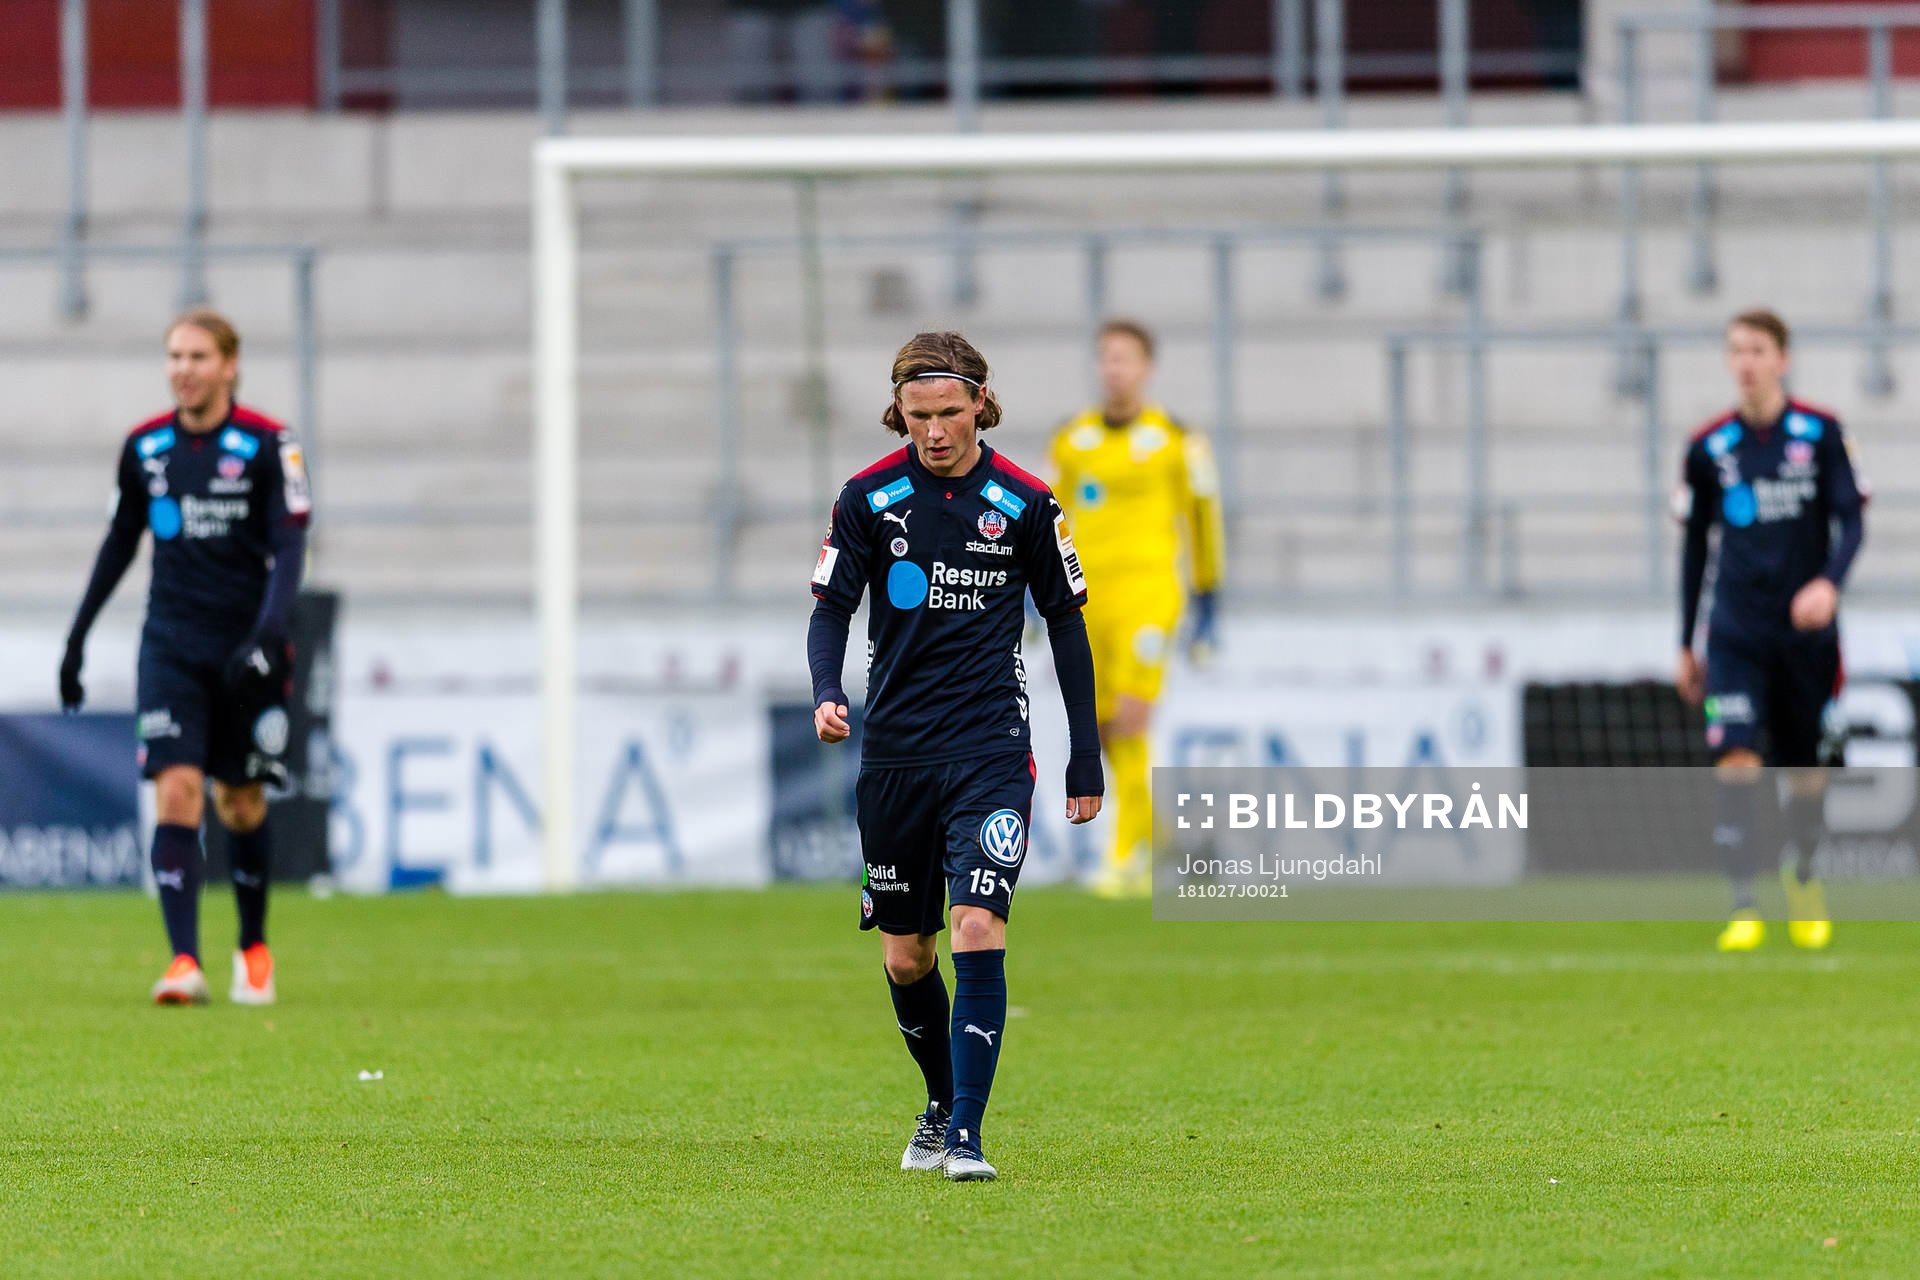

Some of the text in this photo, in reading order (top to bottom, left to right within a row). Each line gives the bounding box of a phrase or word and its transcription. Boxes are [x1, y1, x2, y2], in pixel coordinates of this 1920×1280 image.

[965, 541, 1013, 556] stadium
[931, 561, 1008, 587] Resurs
[928, 585, 986, 610] Bank
[867, 862, 897, 880] Solid
[970, 867, 997, 896] 15
